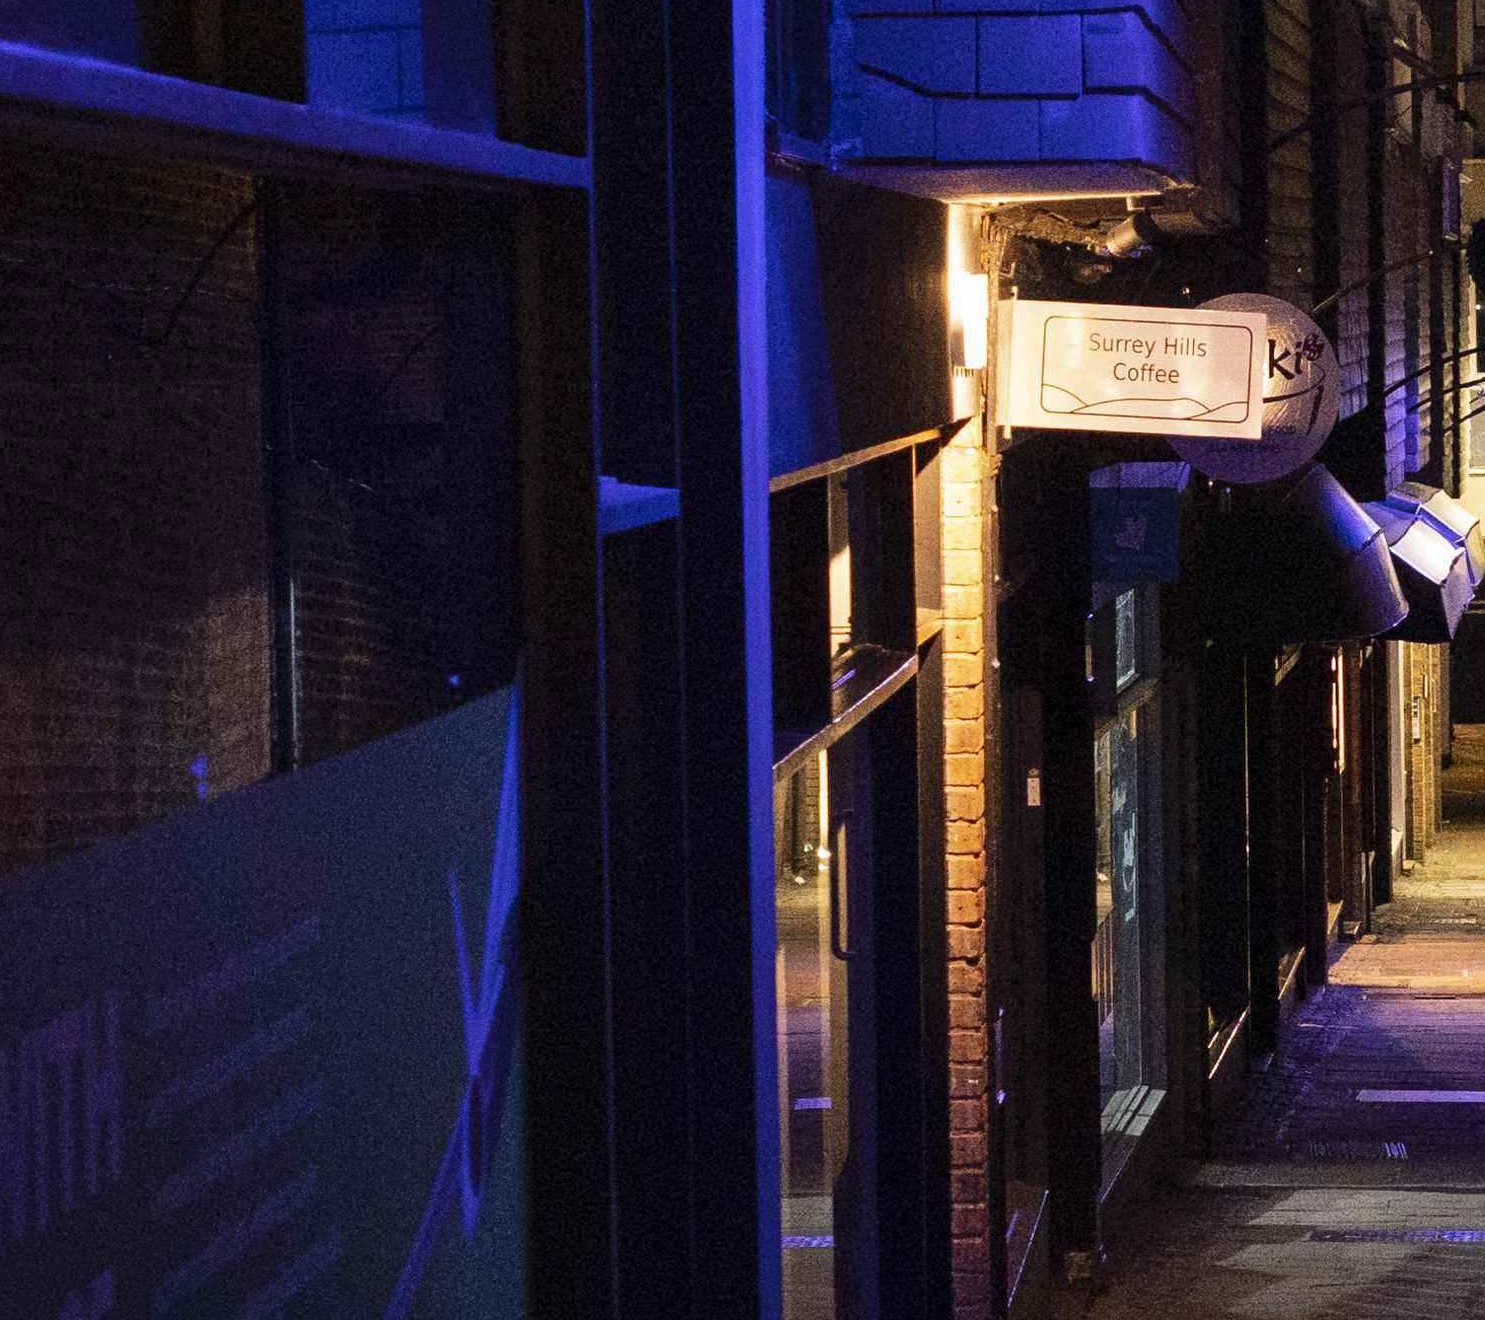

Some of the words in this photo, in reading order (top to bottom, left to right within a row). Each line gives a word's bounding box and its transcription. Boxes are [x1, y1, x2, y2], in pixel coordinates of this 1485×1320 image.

[1089, 332, 1156, 359] Surrey
[1164, 337, 1208, 357] Hills
[1113, 362, 1180, 384] Coffee
